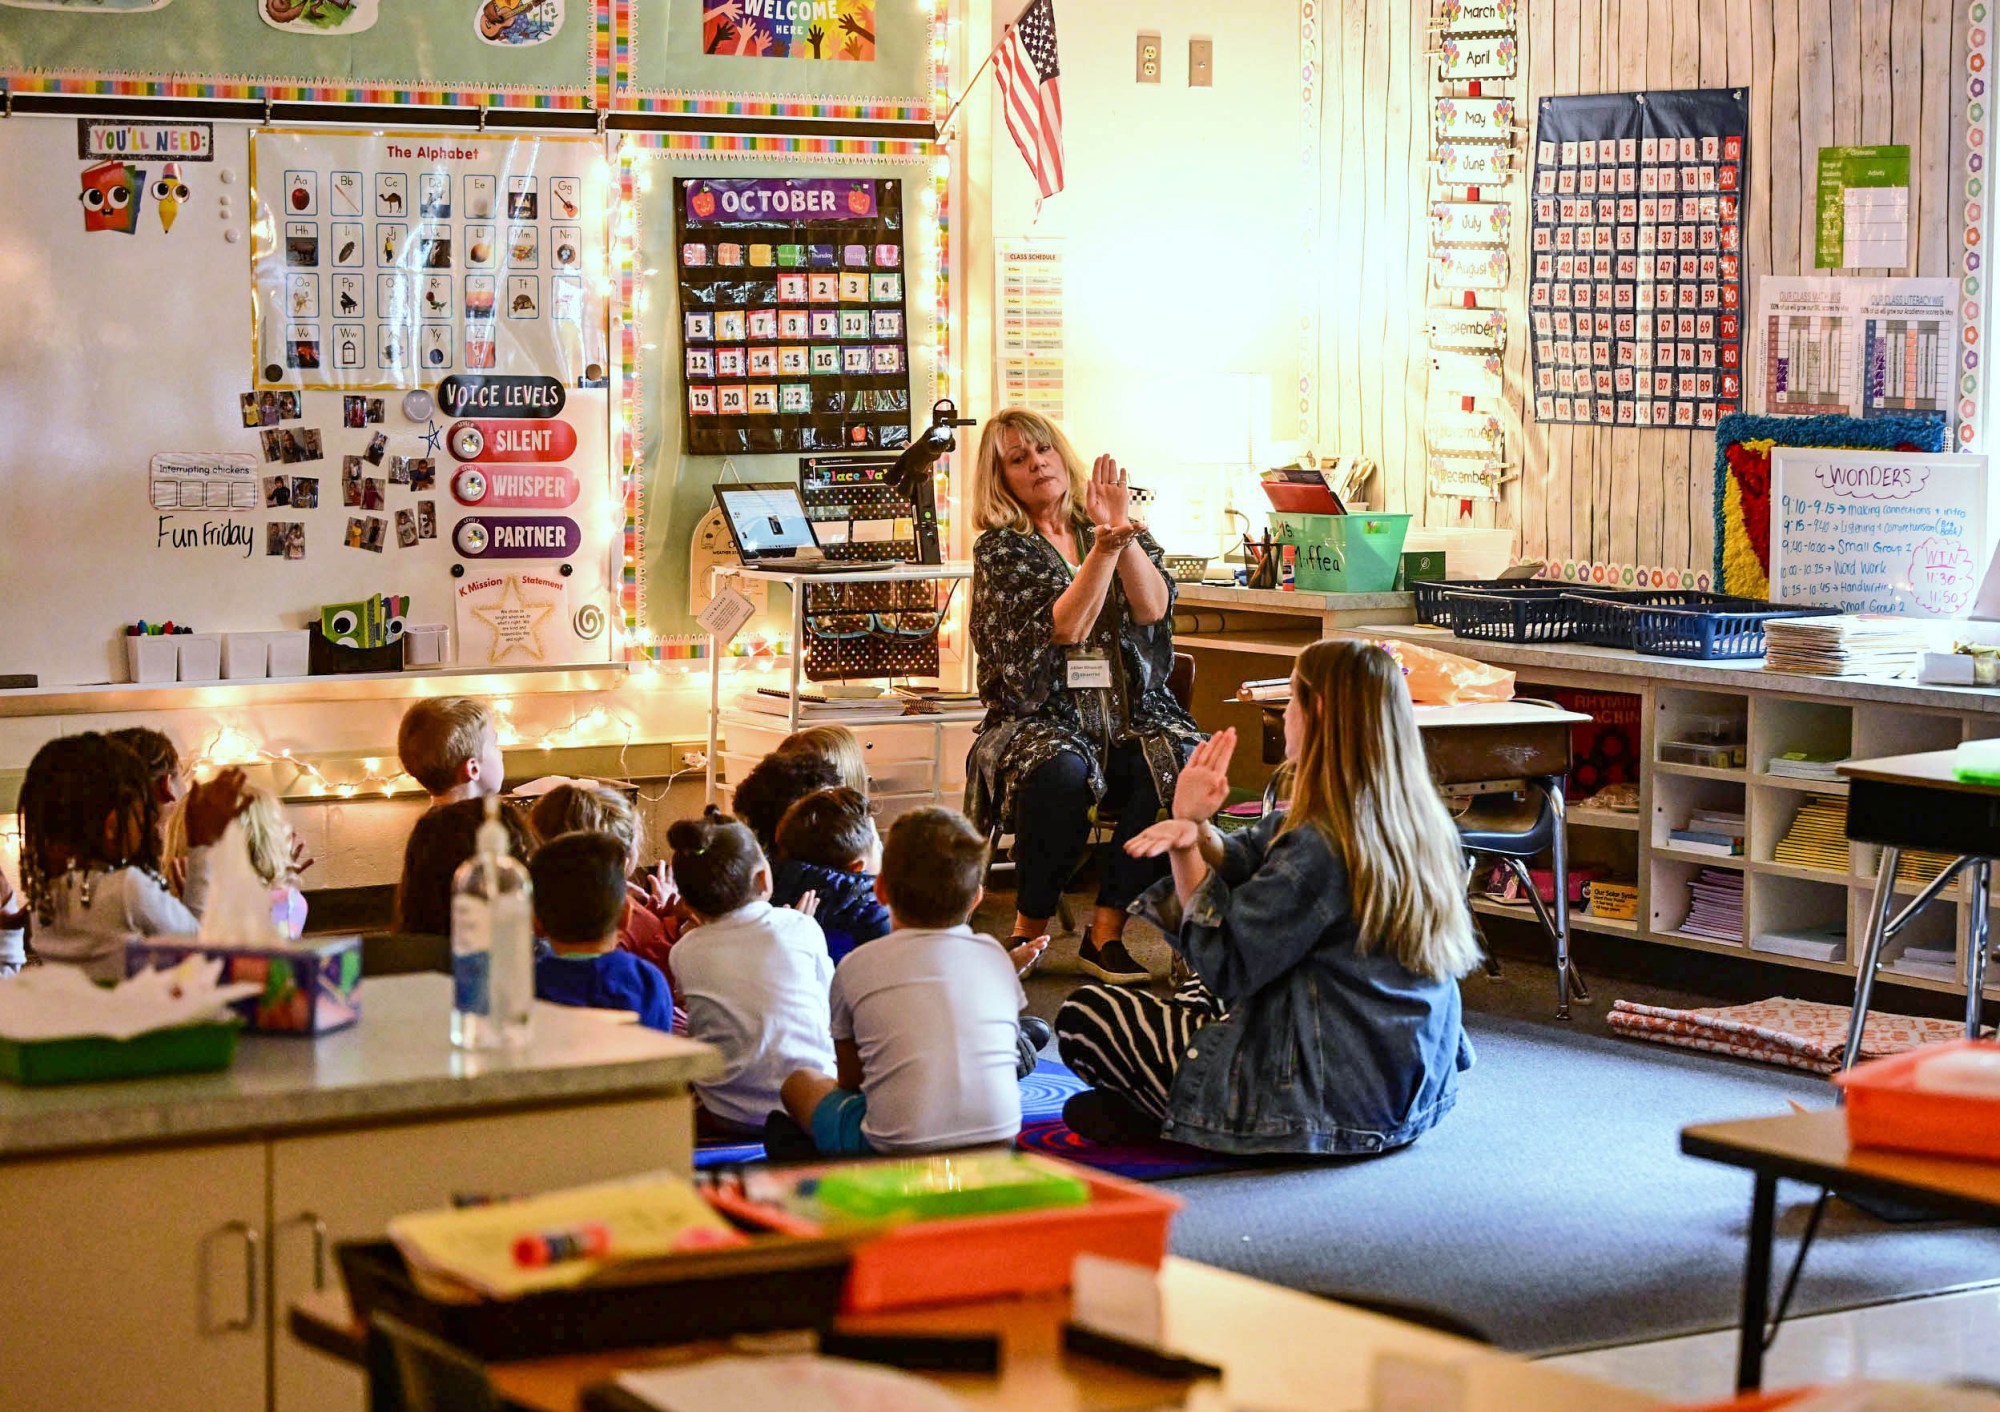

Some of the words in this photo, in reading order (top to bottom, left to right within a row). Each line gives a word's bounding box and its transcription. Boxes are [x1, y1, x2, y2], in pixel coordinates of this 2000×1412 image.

[743, 0, 838, 20] WELCOME
[1464, 5, 1495, 19] March
[776, 25, 803, 35] HERE
[1466, 50, 1489, 67] April
[1465, 111, 1486, 127] May
[94, 127, 149, 151] YOU'LL
[156, 131, 206, 151] NEED:
[387, 146, 412, 160] The
[417, 146, 479, 161] Alphabet
[1545, 147, 1549, 156] 1
[1605, 146, 1610, 156] 4
[1625, 145, 1630, 155] 5
[1665, 145, 1670, 155] 7
[1685, 144, 1690, 155] 8
[1708, 143, 1712, 154] 9
[1728, 142, 1737, 153] 10
[1463, 155, 1485, 171] June
[294, 177, 307, 185] Aa
[340, 175, 353, 186] Bb
[385, 177, 397, 186] Cc
[475, 180, 485, 189] Ee
[558, 180, 572, 193] Gg
[1563, 176, 1571, 187] 12
[1603, 175, 1611, 186] 14
[1686, 173, 1694, 184] 18
[1723, 172, 1732, 183] 20
[721, 190, 837, 212] OCTOBER
[1542, 206, 1549, 215] 21
[1564, 207, 1573, 217] 22
[1602, 206, 1611, 216] 24
[1623, 206, 1633, 216] 25
[1462, 215, 1482, 232] July
[295, 226, 308, 234] Hh
[388, 227, 396, 241] Jj
[515, 230, 531, 238] Mm
[1662, 232, 1671, 243] 37
[1682, 232, 1692, 243] 38
[1703, 232, 1712, 243] 39
[1456, 261, 1487, 279] August
[1660, 261, 1670, 272] 47
[1683, 262, 1693, 273] 48
[1704, 262, 1713, 273] 49
[343, 279, 353, 290] Pp
[432, 279, 440, 288] Rr
[519, 279, 527, 288] Tt
[788, 282, 796, 294] 1
[819, 282, 826, 294] 2
[850, 281, 857, 293] 3
[881, 282, 889, 294] 4
[1619, 291, 1629, 301] 55
[695, 320, 702, 332] 5
[726, 319, 734, 332] 6
[756, 319, 764, 331] 7
[788, 319, 796, 331] 8
[820, 319, 827, 331] 9
[846, 318, 860, 331] 10
[879, 318, 893, 330] 11
[1579, 320, 1589, 331] 63
[1598, 320, 1608, 330] 64
[1620, 320, 1630, 331] 65
[1661, 320, 1670, 331] 67
[1681, 320, 1691, 331] 68
[1700, 321, 1709, 331] 69
[1724, 321, 1734, 331] 70
[298, 329, 308, 337] Vv
[340, 329, 357, 338] Ww
[432, 330, 441, 341] Yy
[691, 357, 707, 369] 12
[722, 356, 737, 368] 13
[754, 355, 770, 368] 14
[785, 355, 800, 367] 15
[817, 354, 832, 366] 16
[848, 354, 861, 366] 17
[1662, 349, 1670, 359] 77
[1700, 380, 1709, 390] 89
[446, 384, 500, 407] VOICE
[505, 384, 558, 406] LEVELS
[695, 394, 708, 406] 19
[724, 393, 739, 406] 20
[754, 393, 768, 405] 21
[786, 392, 801, 404] 22
[1702, 409, 1712, 419] 99
[496, 430, 552, 452] SILENT
[159, 464, 210, 476] Interrupting
[213, 464, 250, 475] chickens
[823, 471, 860, 482] Place
[865, 469, 887, 480] Va
[1440, 468, 1489, 485] December
[1830, 465, 1912, 487] WONDERS
[492, 474, 566, 497] WHISPER
[1849, 504, 1880, 517] Making
[1944, 507, 1966, 518] intro
[157, 515, 198, 548] Fun
[203, 518, 254, 559] Friday
[494, 526, 566, 548] PARTNER
[1838, 539, 1869, 554] Small
[1873, 542, 1903, 556] Group
[1926, 547, 1958, 564] WIN
[1834, 560, 1856, 575] Word
[1861, 561, 1886, 574] Work
[459, 586, 468, 598] K
[467, 577, 503, 594] Mission
[522, 575, 564, 591] Statement
[1841, 601, 1864, 613] Small
[1869, 599, 1895, 613] Group
[1900, 602, 1904, 612] 2
